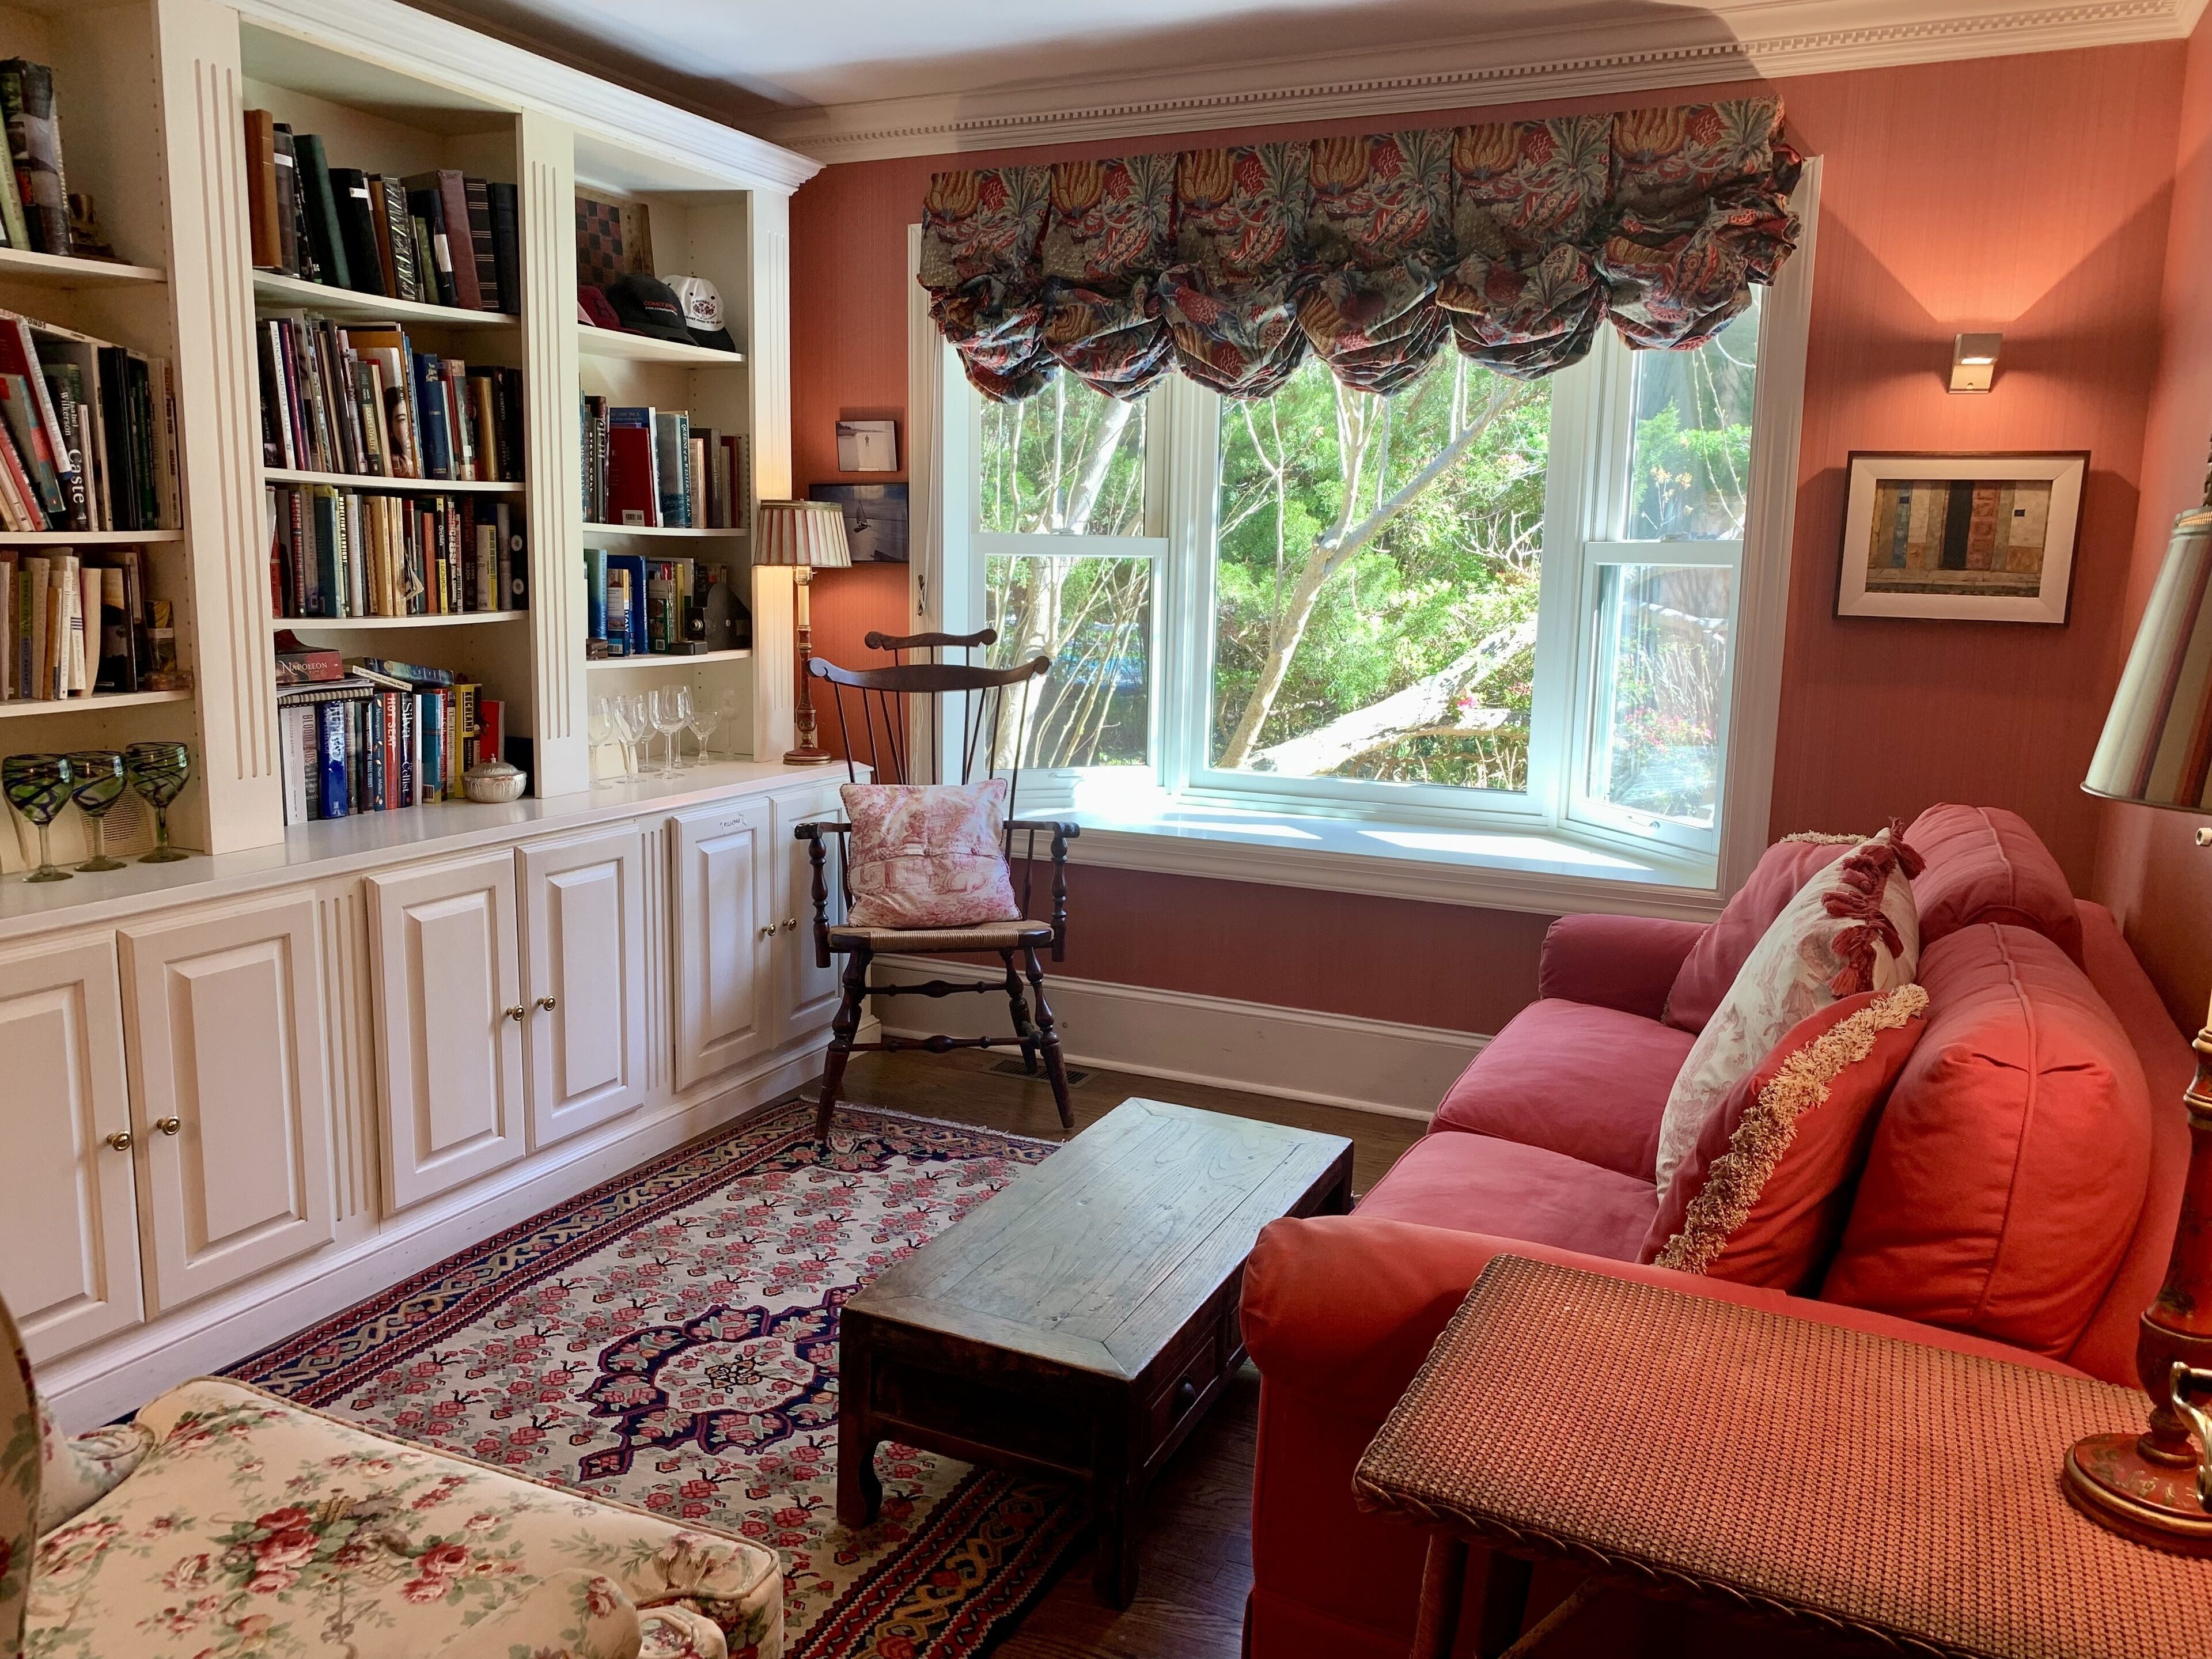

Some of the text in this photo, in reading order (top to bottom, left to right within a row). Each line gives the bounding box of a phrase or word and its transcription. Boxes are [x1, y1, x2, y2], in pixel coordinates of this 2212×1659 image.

[274, 329, 282, 366] MEXICAN
[278, 369, 287, 407] COUNTRY
[60, 392, 73, 437] Wilkerson
[70, 401, 79, 427] Isabel
[368, 429, 376, 450] CIVILITY
[68, 449, 86, 505] Caste
[339, 497, 347, 531] MADELEINE
[291, 493, 305, 606] FASCISM MADELEINE ALBRIGHT
[387, 698, 396, 748] HOT SEAT
[402, 702, 413, 739] Silva
[465, 691, 474, 732] KOCHLAND
[302, 714, 316, 763] BLOODLANDS
[402, 761, 410, 793] Cellist
